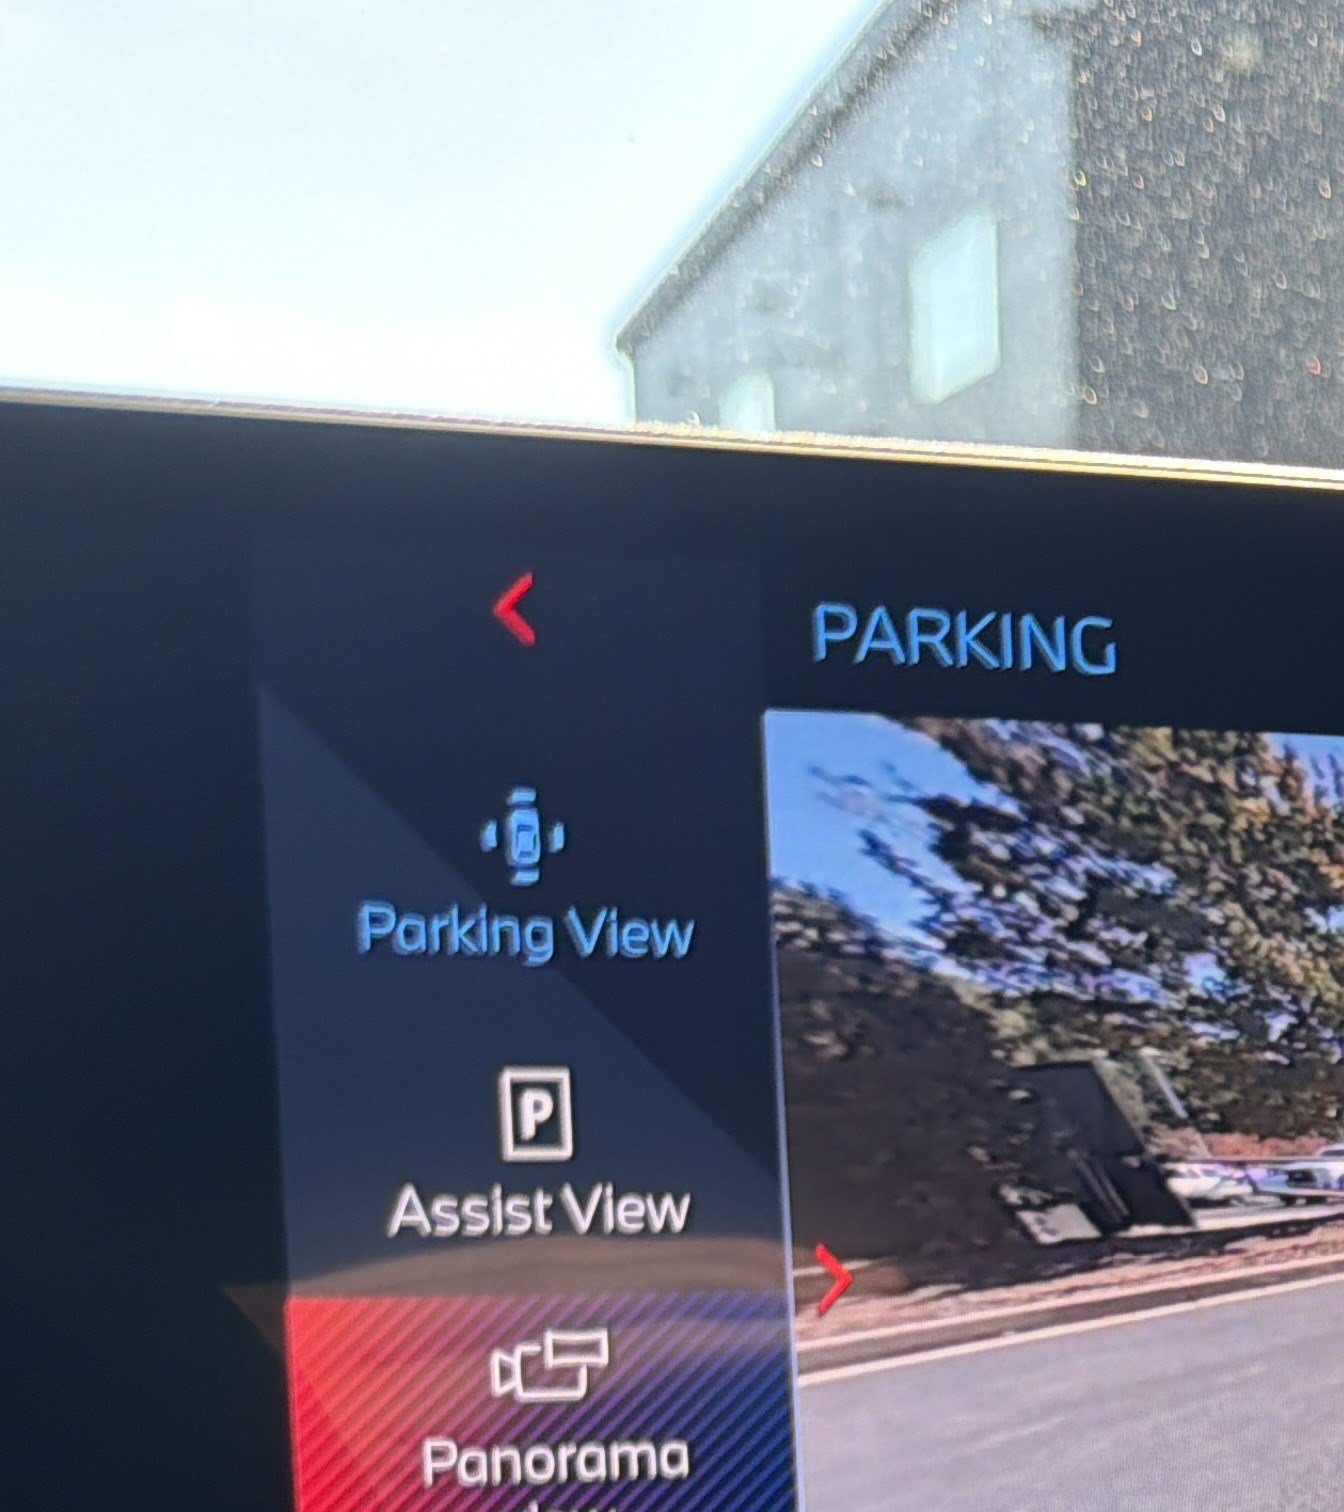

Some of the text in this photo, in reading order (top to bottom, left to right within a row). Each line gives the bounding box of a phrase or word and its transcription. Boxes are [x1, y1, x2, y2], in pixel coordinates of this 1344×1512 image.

[814, 602, 1118, 676] PARKING
[358, 902, 696, 967] Parking View
[389, 1184, 691, 1237] Assist View
[422, 1435, 690, 1488] Panorama
